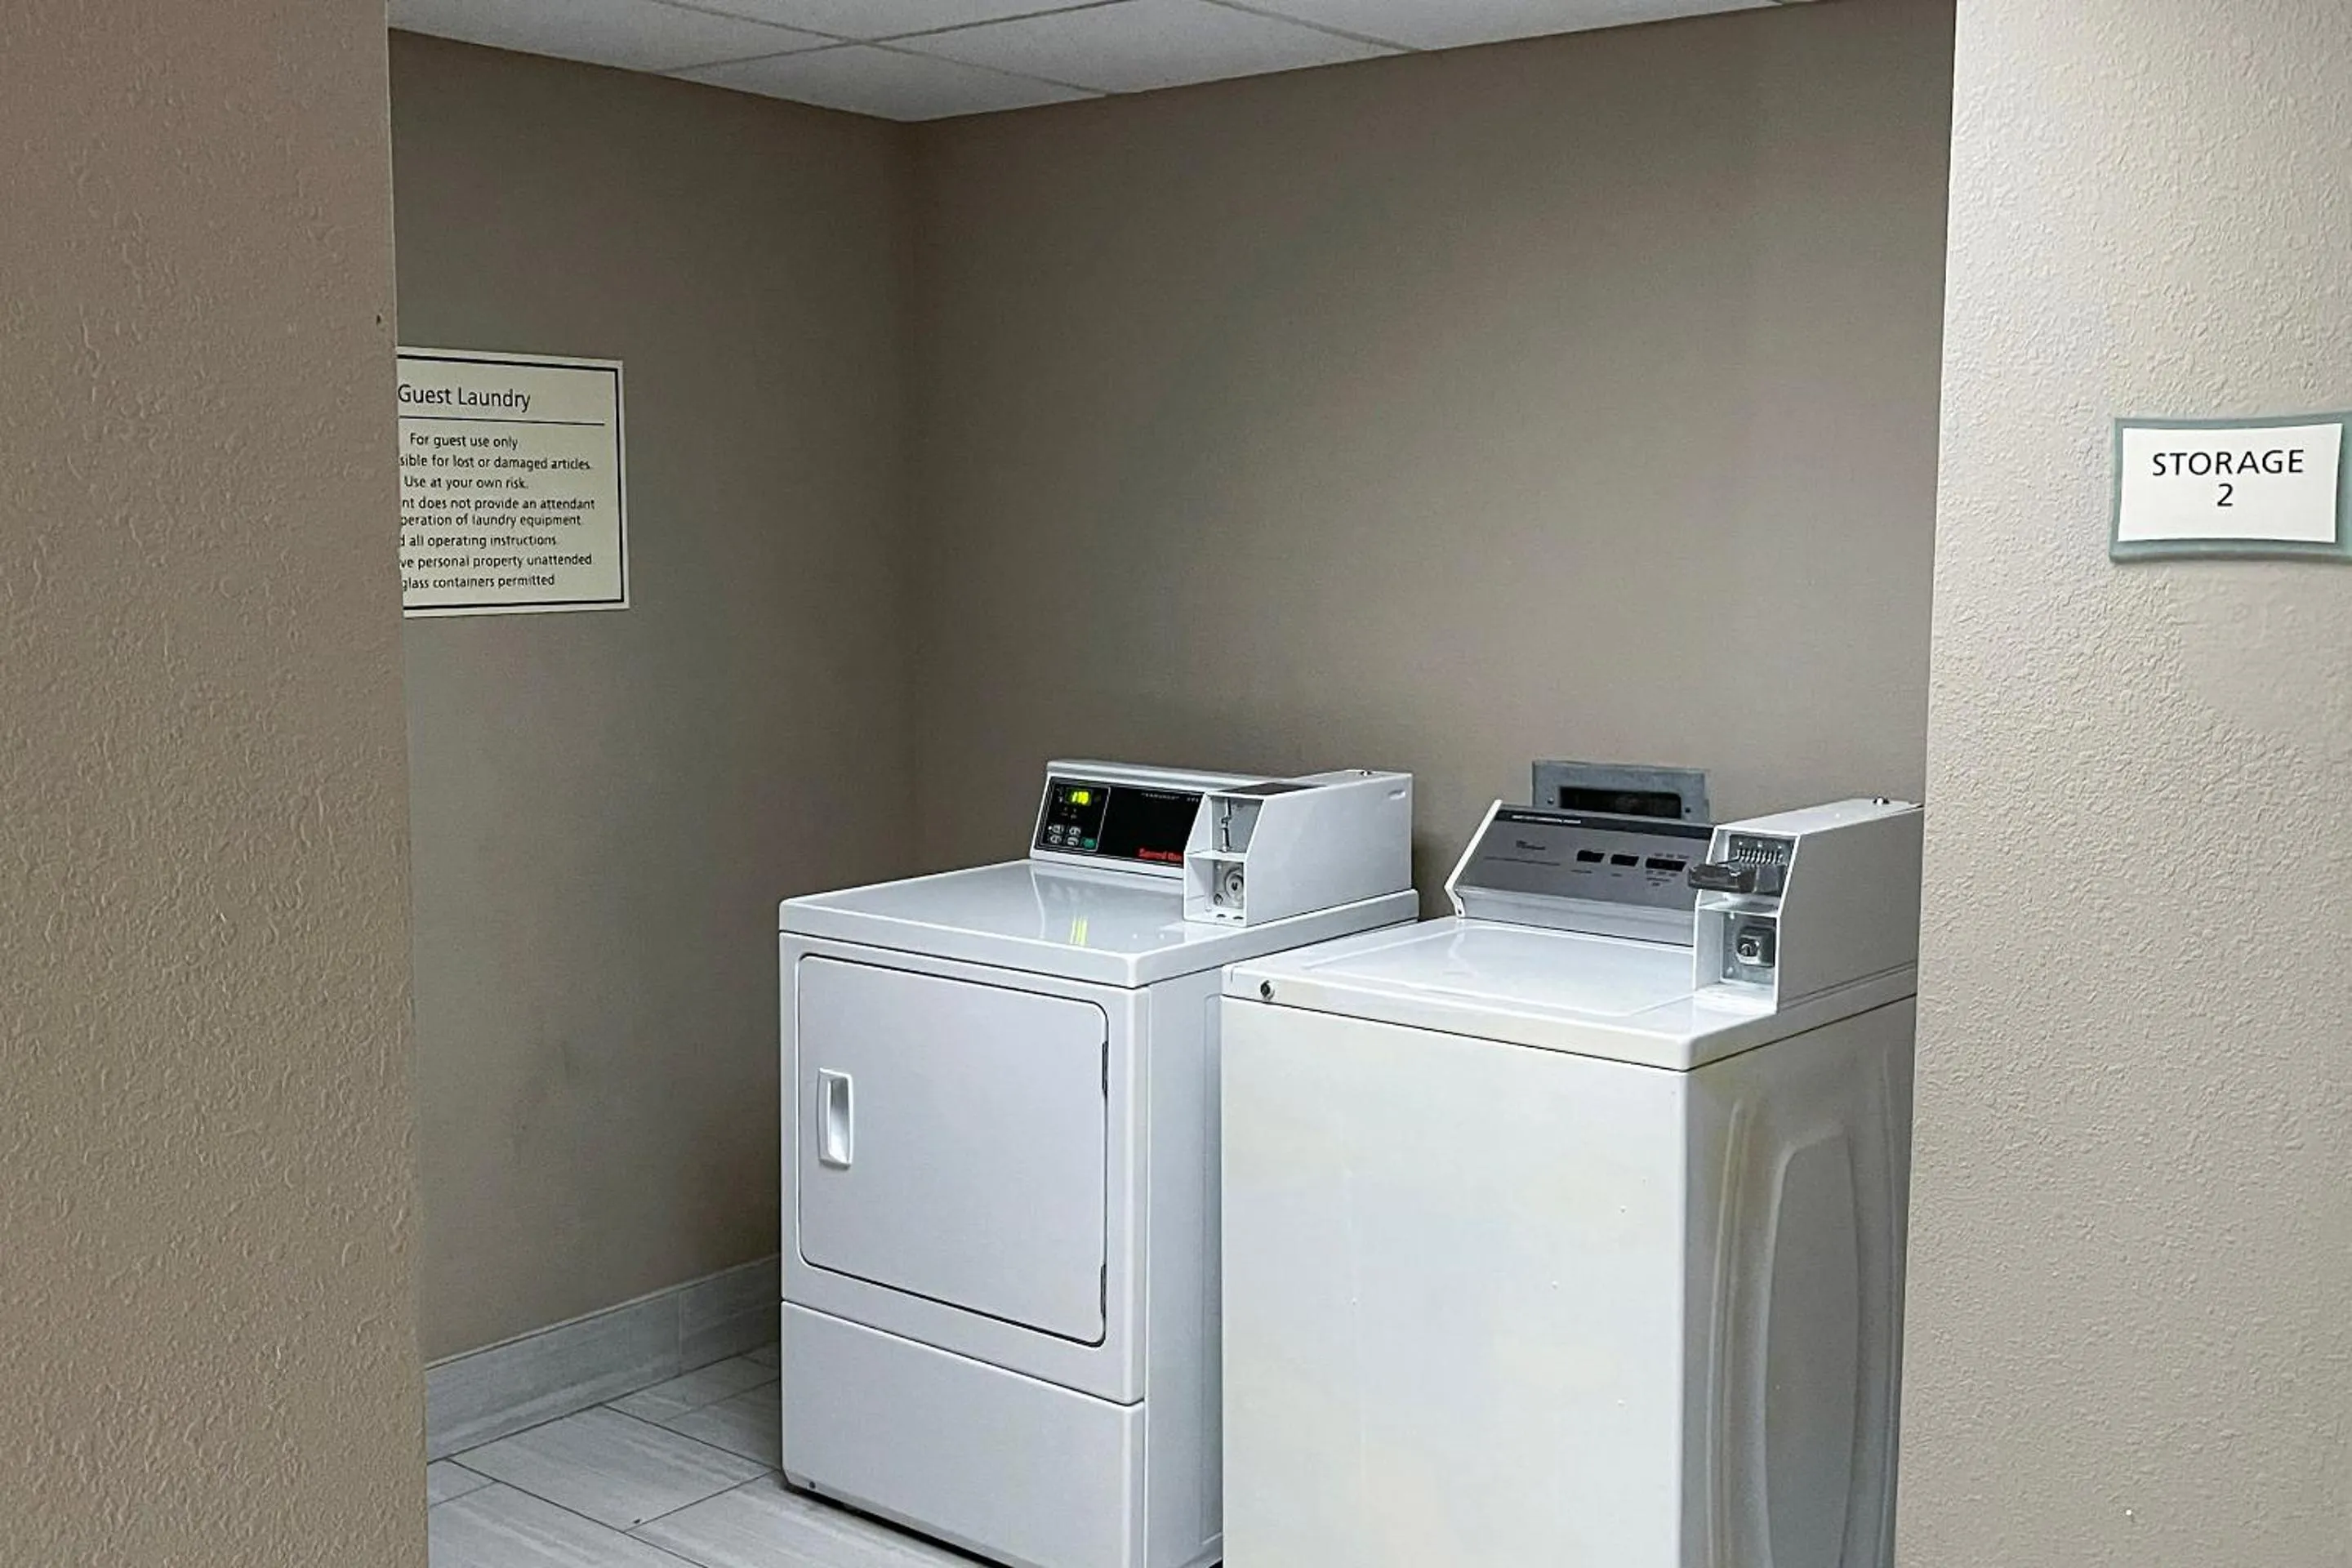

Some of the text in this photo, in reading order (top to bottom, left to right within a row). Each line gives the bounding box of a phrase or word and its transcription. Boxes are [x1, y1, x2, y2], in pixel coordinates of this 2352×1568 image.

[398, 383, 531, 413] Guest Laundry
[410, 432, 429, 445] For
[434, 435, 466, 449] guest
[470, 438, 490, 448] use
[432, 454, 449, 466] for
[452, 454, 475, 468] lost
[478, 458, 491, 468] or
[493, 457, 548, 472] damaged
[2152, 449, 2304, 476] STORAGE
[403, 475, 426, 488] Use
[430, 478, 442, 488] at
[446, 479, 473, 491] your
[476, 479, 503, 488] own
[2216, 483, 2234, 507] 2
[418, 497, 448, 509] does
[451, 498, 471, 509] not
[474, 497, 519, 512] provide
[523, 500, 537, 509] an
[540, 497, 595, 510] attendant
[456, 513, 469, 526] of
[473, 514, 517, 529] laundry
[409, 534, 425, 546] all
[427, 536, 488, 550] operating
[417, 555, 470, 571] personal
[473, 555, 524, 569] property
[432, 577, 496, 589] containers
